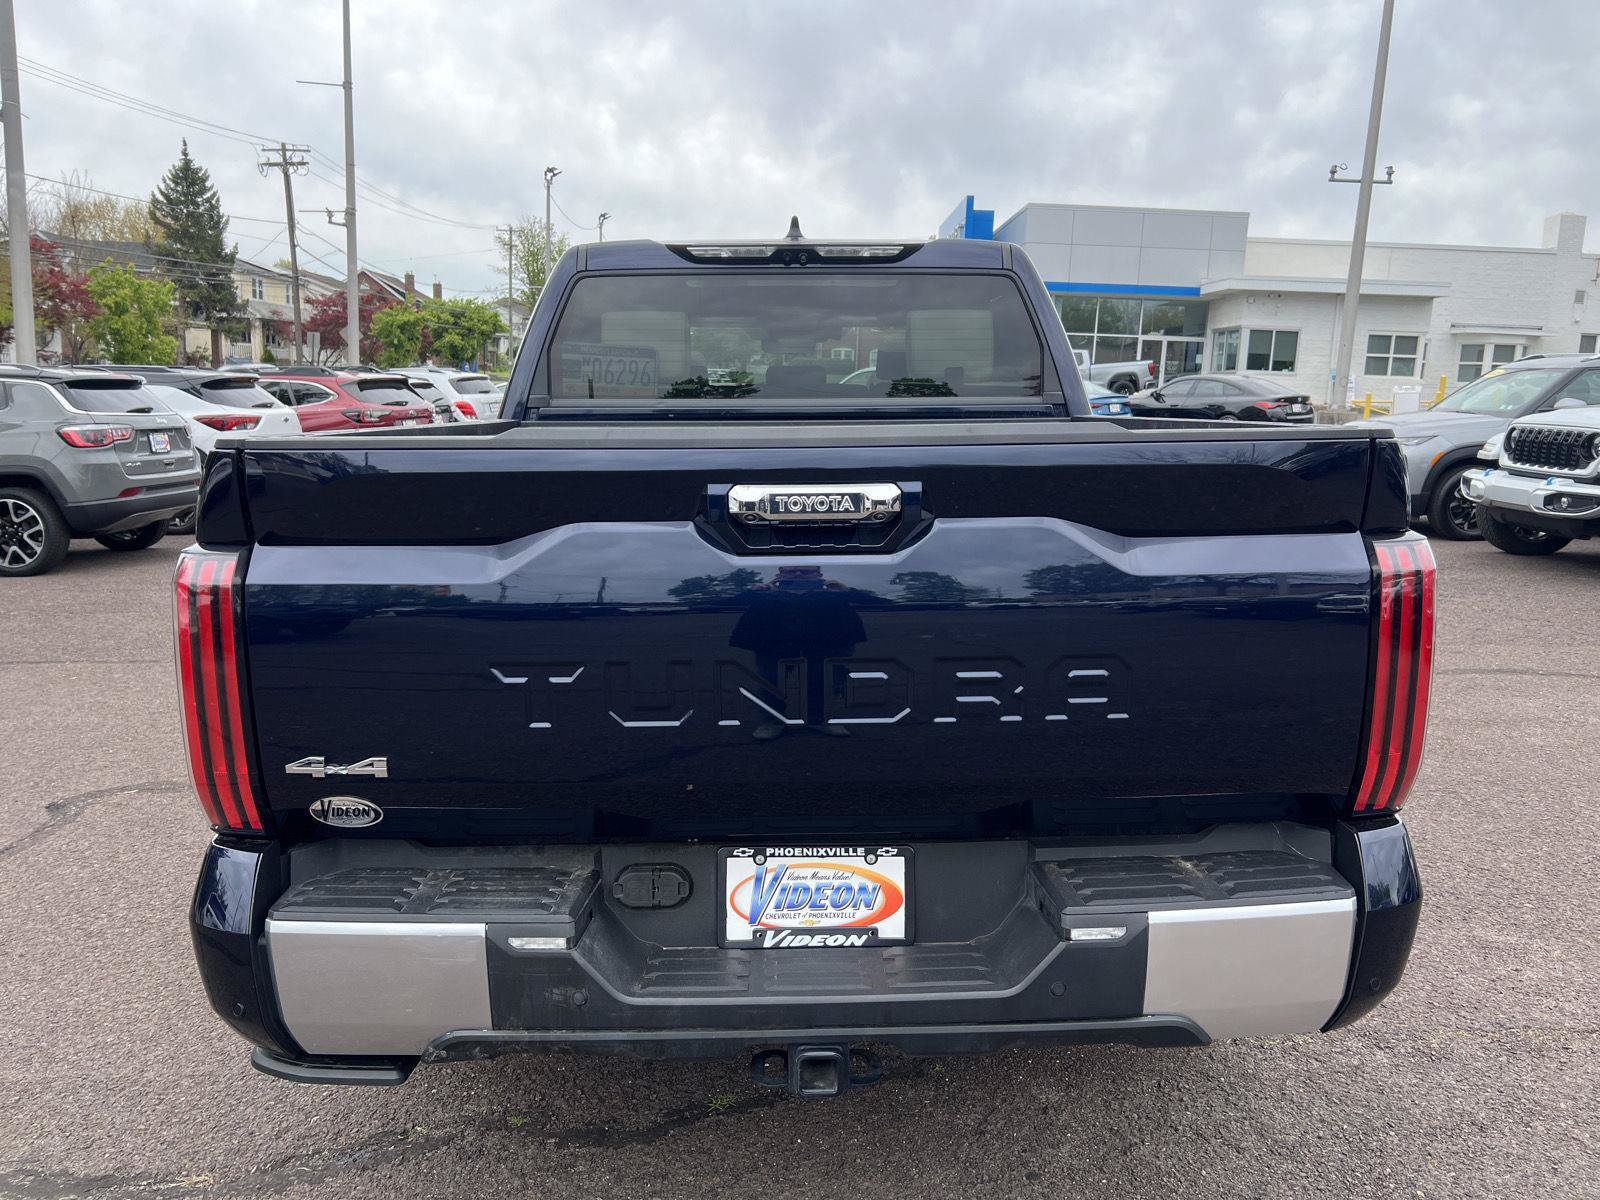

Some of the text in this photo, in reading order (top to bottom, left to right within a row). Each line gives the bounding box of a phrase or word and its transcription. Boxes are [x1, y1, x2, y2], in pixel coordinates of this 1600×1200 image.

[775, 495, 855, 512] TOYOTA
[486, 655, 1133, 729] TUNDRA
[320, 800, 371, 821] VIDEON
[766, 847, 866, 857] PHOENIXVILLE
[786, 870, 855, 881] Videon Means Value!
[748, 863, 882, 926] VIDEON
[765, 912, 801, 920] CHEVROLET
[762, 929, 869, 948] VIDEON
